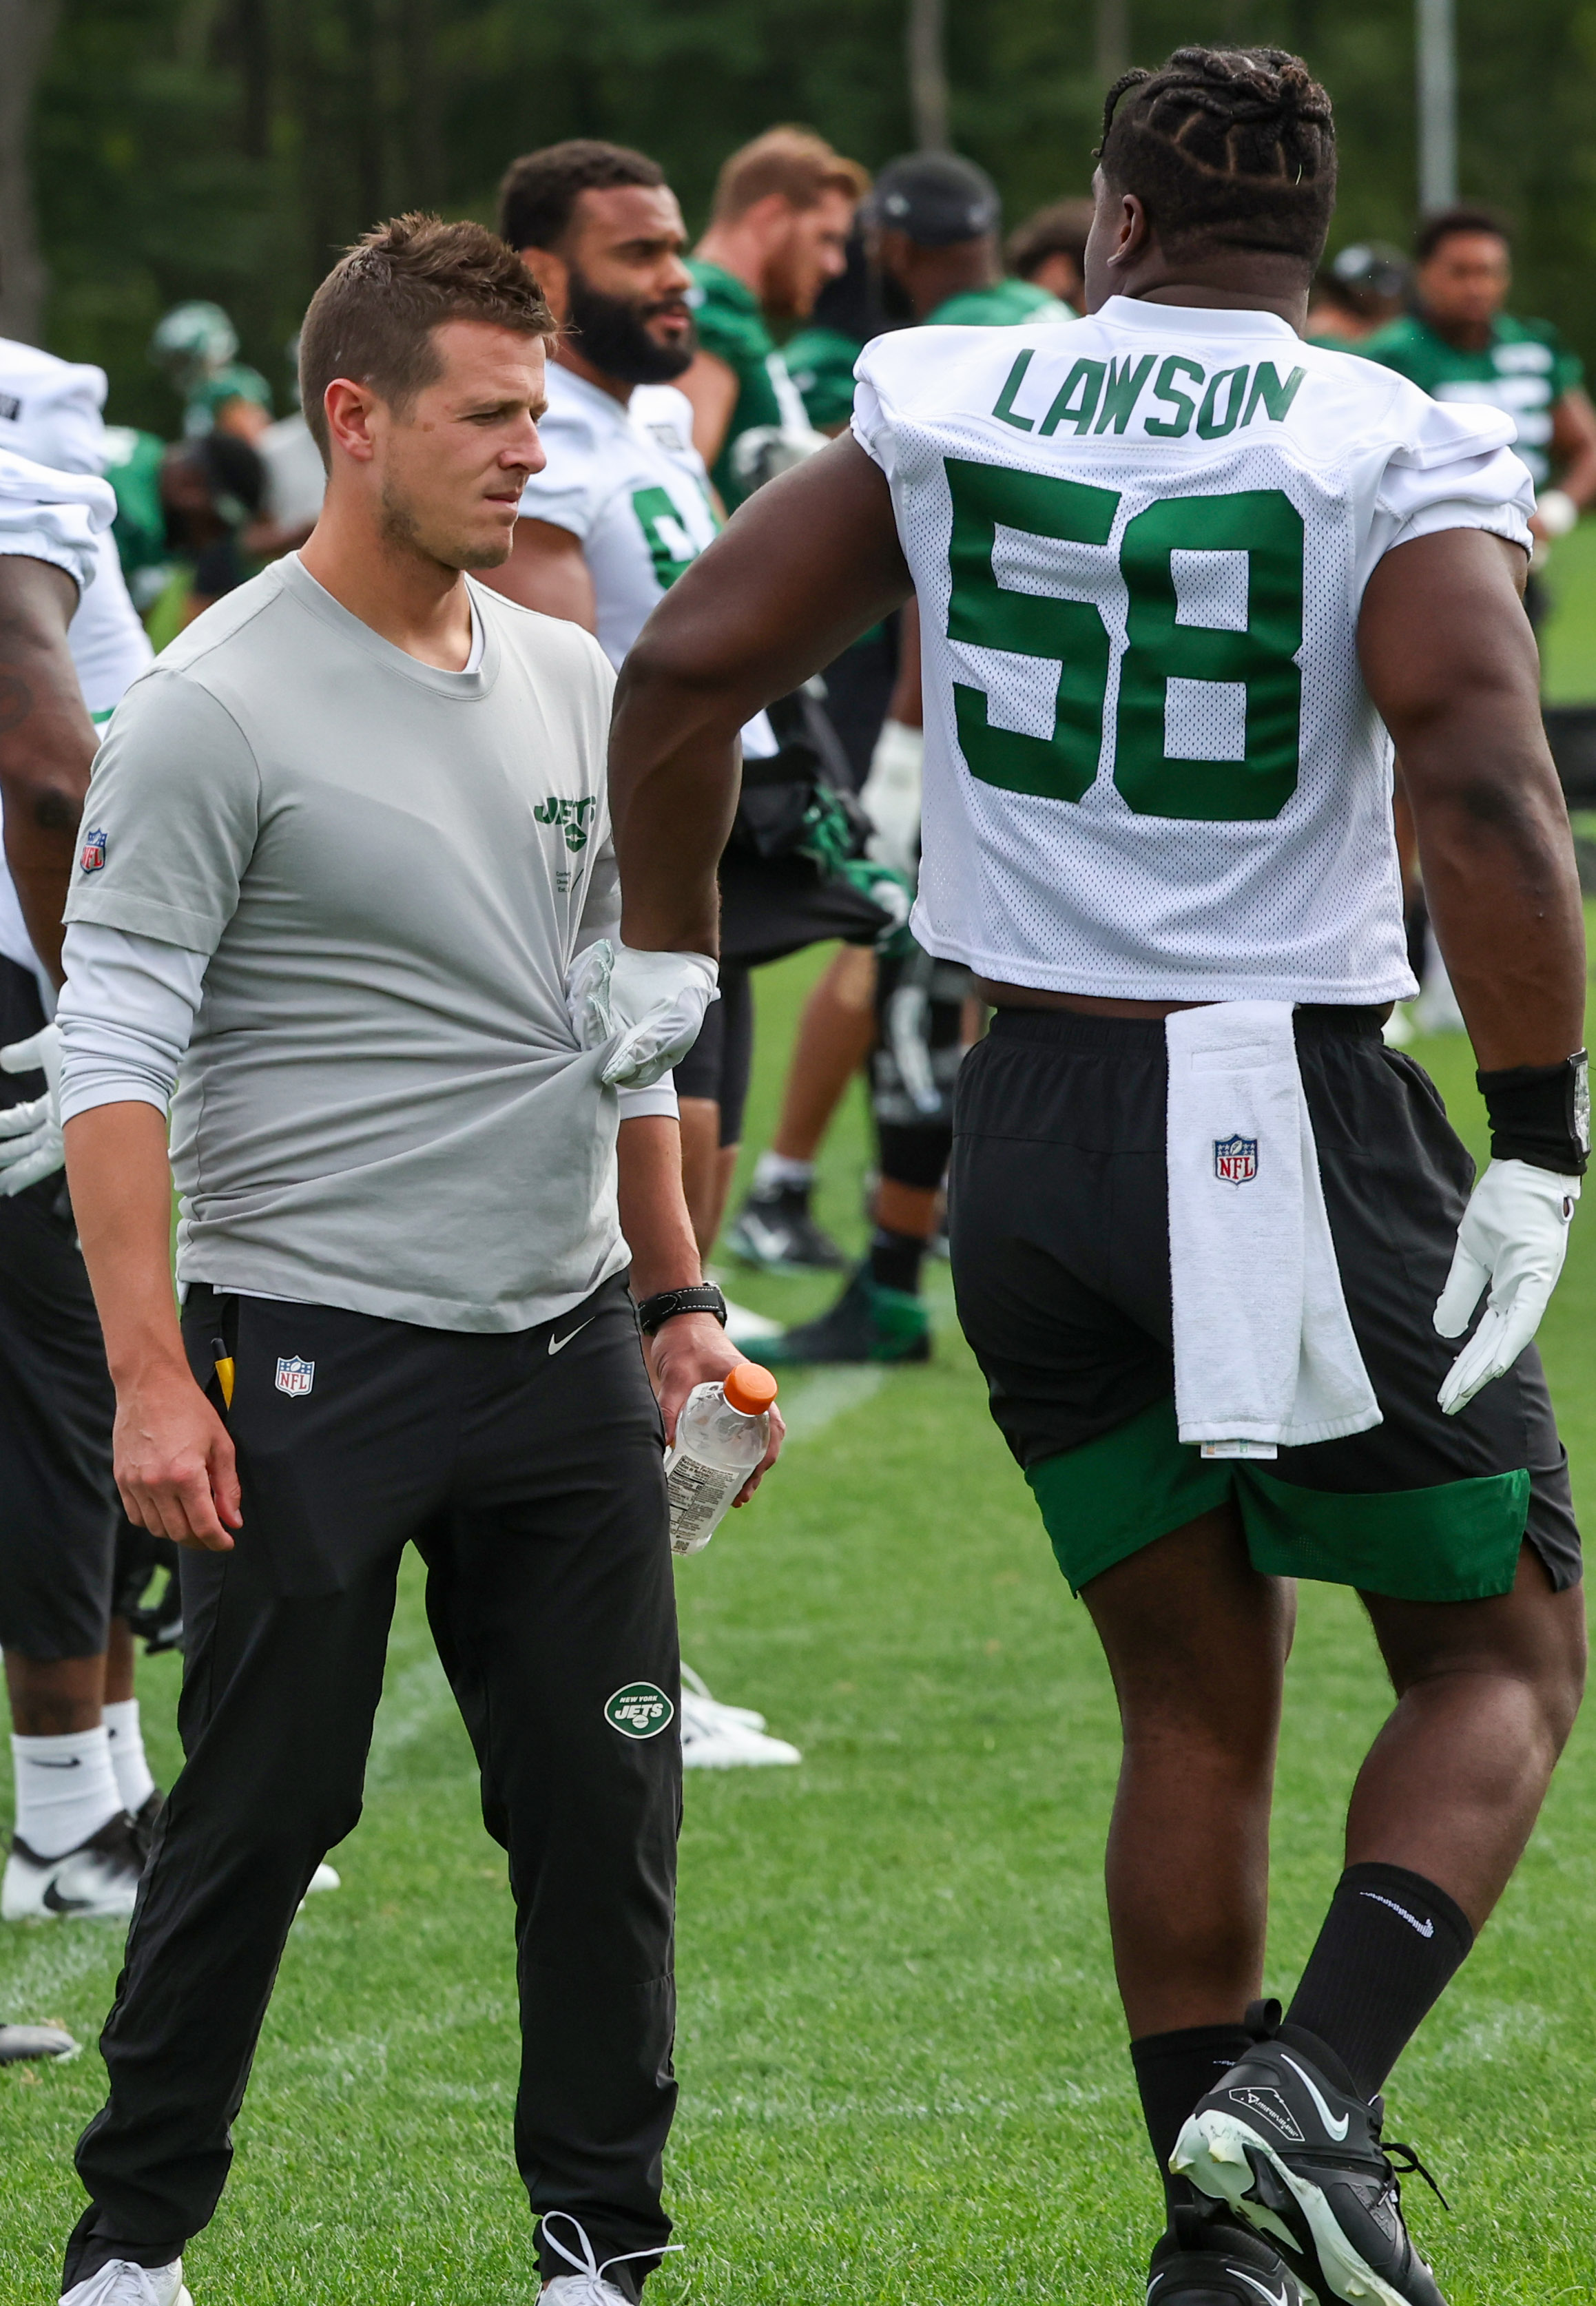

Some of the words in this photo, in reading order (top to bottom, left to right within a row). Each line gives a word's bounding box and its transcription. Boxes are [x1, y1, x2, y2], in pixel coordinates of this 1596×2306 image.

[992, 349, 1308, 440] LAWSON
[944, 457, 1305, 822] 58
[1219, 1157, 1254, 1179] NFL
[280, 1372, 307, 1391] NFL
[614, 1703, 664, 1720] JETS
